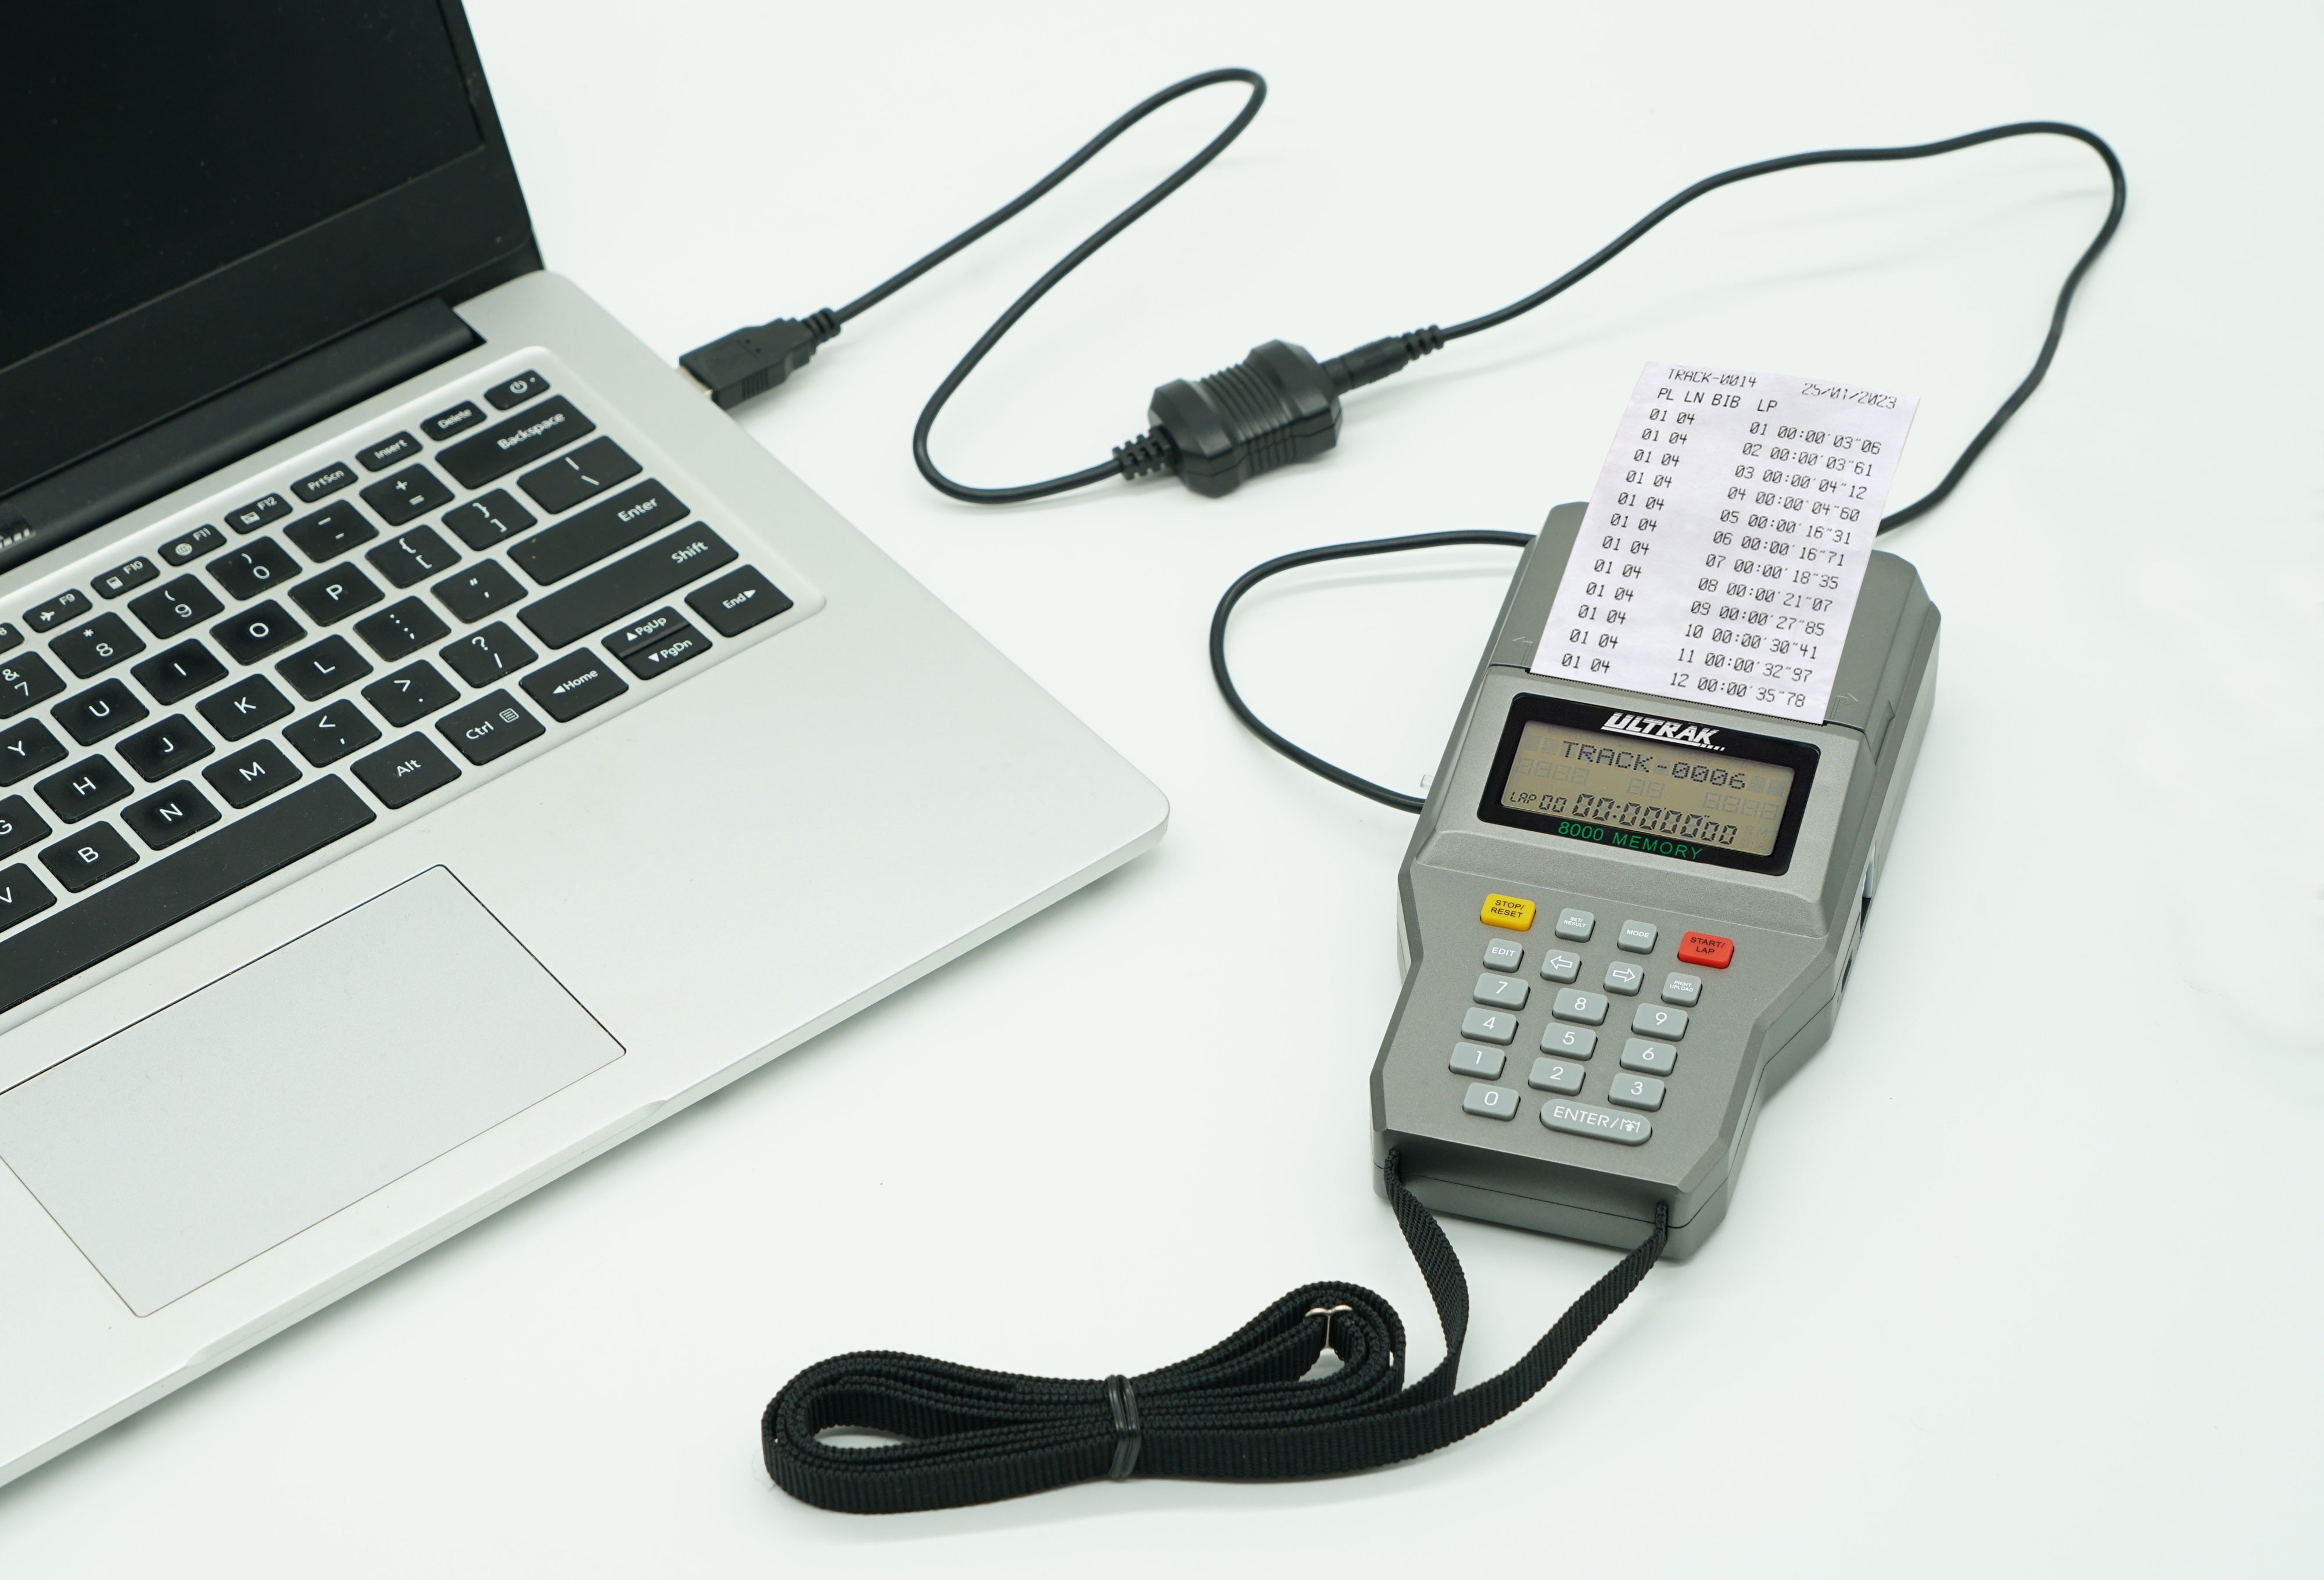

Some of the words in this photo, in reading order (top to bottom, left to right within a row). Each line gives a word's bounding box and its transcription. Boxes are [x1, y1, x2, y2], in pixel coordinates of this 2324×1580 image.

[1668, 369, 1756, 388] TRACK-0014
[1801, 383, 1897, 409] 25/01/2023
[1657, 387, 1674, 401] PL
[1684, 390, 1705, 404] LN
[1711, 393, 1741, 408] BIB
[1757, 399, 1778, 412] LP
[437, 408, 472, 430] Delete
[1649, 408, 1667, 422] 01
[1676, 412, 1695, 425] 04
[1749, 422, 1767, 436] 01
[497, 412, 565, 450] Backspace
[374, 439, 408, 459] Insert
[1641, 428, 1659, 441] 01
[1668, 432, 1687, 445] 04
[1742, 442, 1762, 457] 02
[1633, 448, 1652, 463] 01
[1660, 453, 1680, 467] 04
[1734, 465, 1755, 479] 03
[307, 468, 345, 491] PrtScn
[1626, 470, 1644, 484] 01
[1653, 475, 1672, 489] 04
[1727, 486, 1746, 501] 04
[257, 497, 277, 510] F12
[618, 498, 657, 522] Enter
[1618, 492, 1636, 507] 01
[1645, 496, 1665, 511] 04
[1720, 509, 1740, 524] 05
[193, 528, 211, 541] F11
[1610, 513, 1629, 528] 01
[1638, 518, 1657, 532] 04
[1713, 530, 1733, 545] 06
[671, 542, 708, 563] Shift
[1602, 536, 1621, 551] 01
[1630, 540, 1649, 555] 04
[1705, 554, 1726, 568] 07
[123, 561, 143, 574] F10
[1594, 559, 1613, 574] 01
[1622, 564, 1642, 579] 04
[1698, 578, 1719, 592] 08
[59, 593, 76, 605] F9
[326, 584, 343, 601] P
[722, 593, 747, 609] End
[1586, 581, 1605, 597] 01
[1614, 587, 1634, 602] 04
[1690, 601, 1711, 616] 09
[175, 604, 192, 617] 9
[249, 622, 269, 638] O
[635, 616, 667, 637] PgUp
[1577, 604, 1597, 620] 01
[1606, 609, 1626, 624] 04
[1685, 623, 1704, 639] 10
[96, 642, 113, 657] 8
[472, 636, 489, 651] ?
[659, 640, 693, 658] PgDn
[1569, 629, 1588, 645] 01
[1598, 634, 1618, 649] 04
[1677, 648, 1694, 663] 11
[2, 669, 20, 681] &
[314, 661, 336, 674] L
[1561, 653, 1580, 669] 01
[1590, 658, 1610, 673] 04
[1670, 672, 1690, 688] 12
[14, 681, 28, 696] 7
[562, 670, 598, 690] Home
[88, 701, 110, 717] U
[234, 696, 256, 714] K
[466, 721, 494, 739] Ctrl
[1601, 712, 1722, 748] ULTRAK
[7, 740, 26, 756] Y
[163, 737, 174, 753] J
[239, 762, 266, 781] M
[397, 760, 421, 777] Alt
[1562, 740, 1746, 791] TRACK-0006
[73, 777, 96, 795] H
[1510, 791, 1537, 805] LAP
[1538, 795, 1567, 813] 00
[159, 803, 183, 821] N
[0, 820, 12, 835] G
[1558, 822, 1604, 842] 8000
[1612, 832, 1702, 860] MEMORY
[77, 846, 99, 863] B
[1490, 907, 1523, 918] RESET
[1495, 900, 1525, 910] STOP/
[1563, 919, 1587, 928] RESULT
[1626, 929, 1650, 938] MODE
[1690, 936, 1726, 948] START/
[1491, 947, 1516, 957] EDIT
[1695, 946, 1715, 954] LAP
[1495, 981, 1508, 994] 7
[1669, 982, 1694, 992] UPLOAD
[1575, 997, 1587, 1011] 8
[1483, 1017, 1495, 1030] 4
[1655, 1012, 1667, 1025] 9
[1562, 1031, 1575, 1045] 5
[1476, 1050, 1482, 1064] 1
[1642, 1047, 1655, 1061] 6
[1550, 1066, 1563, 1080] 2
[1630, 1082, 1643, 1095] 3
[1484, 1091, 1499, 1105] 0
